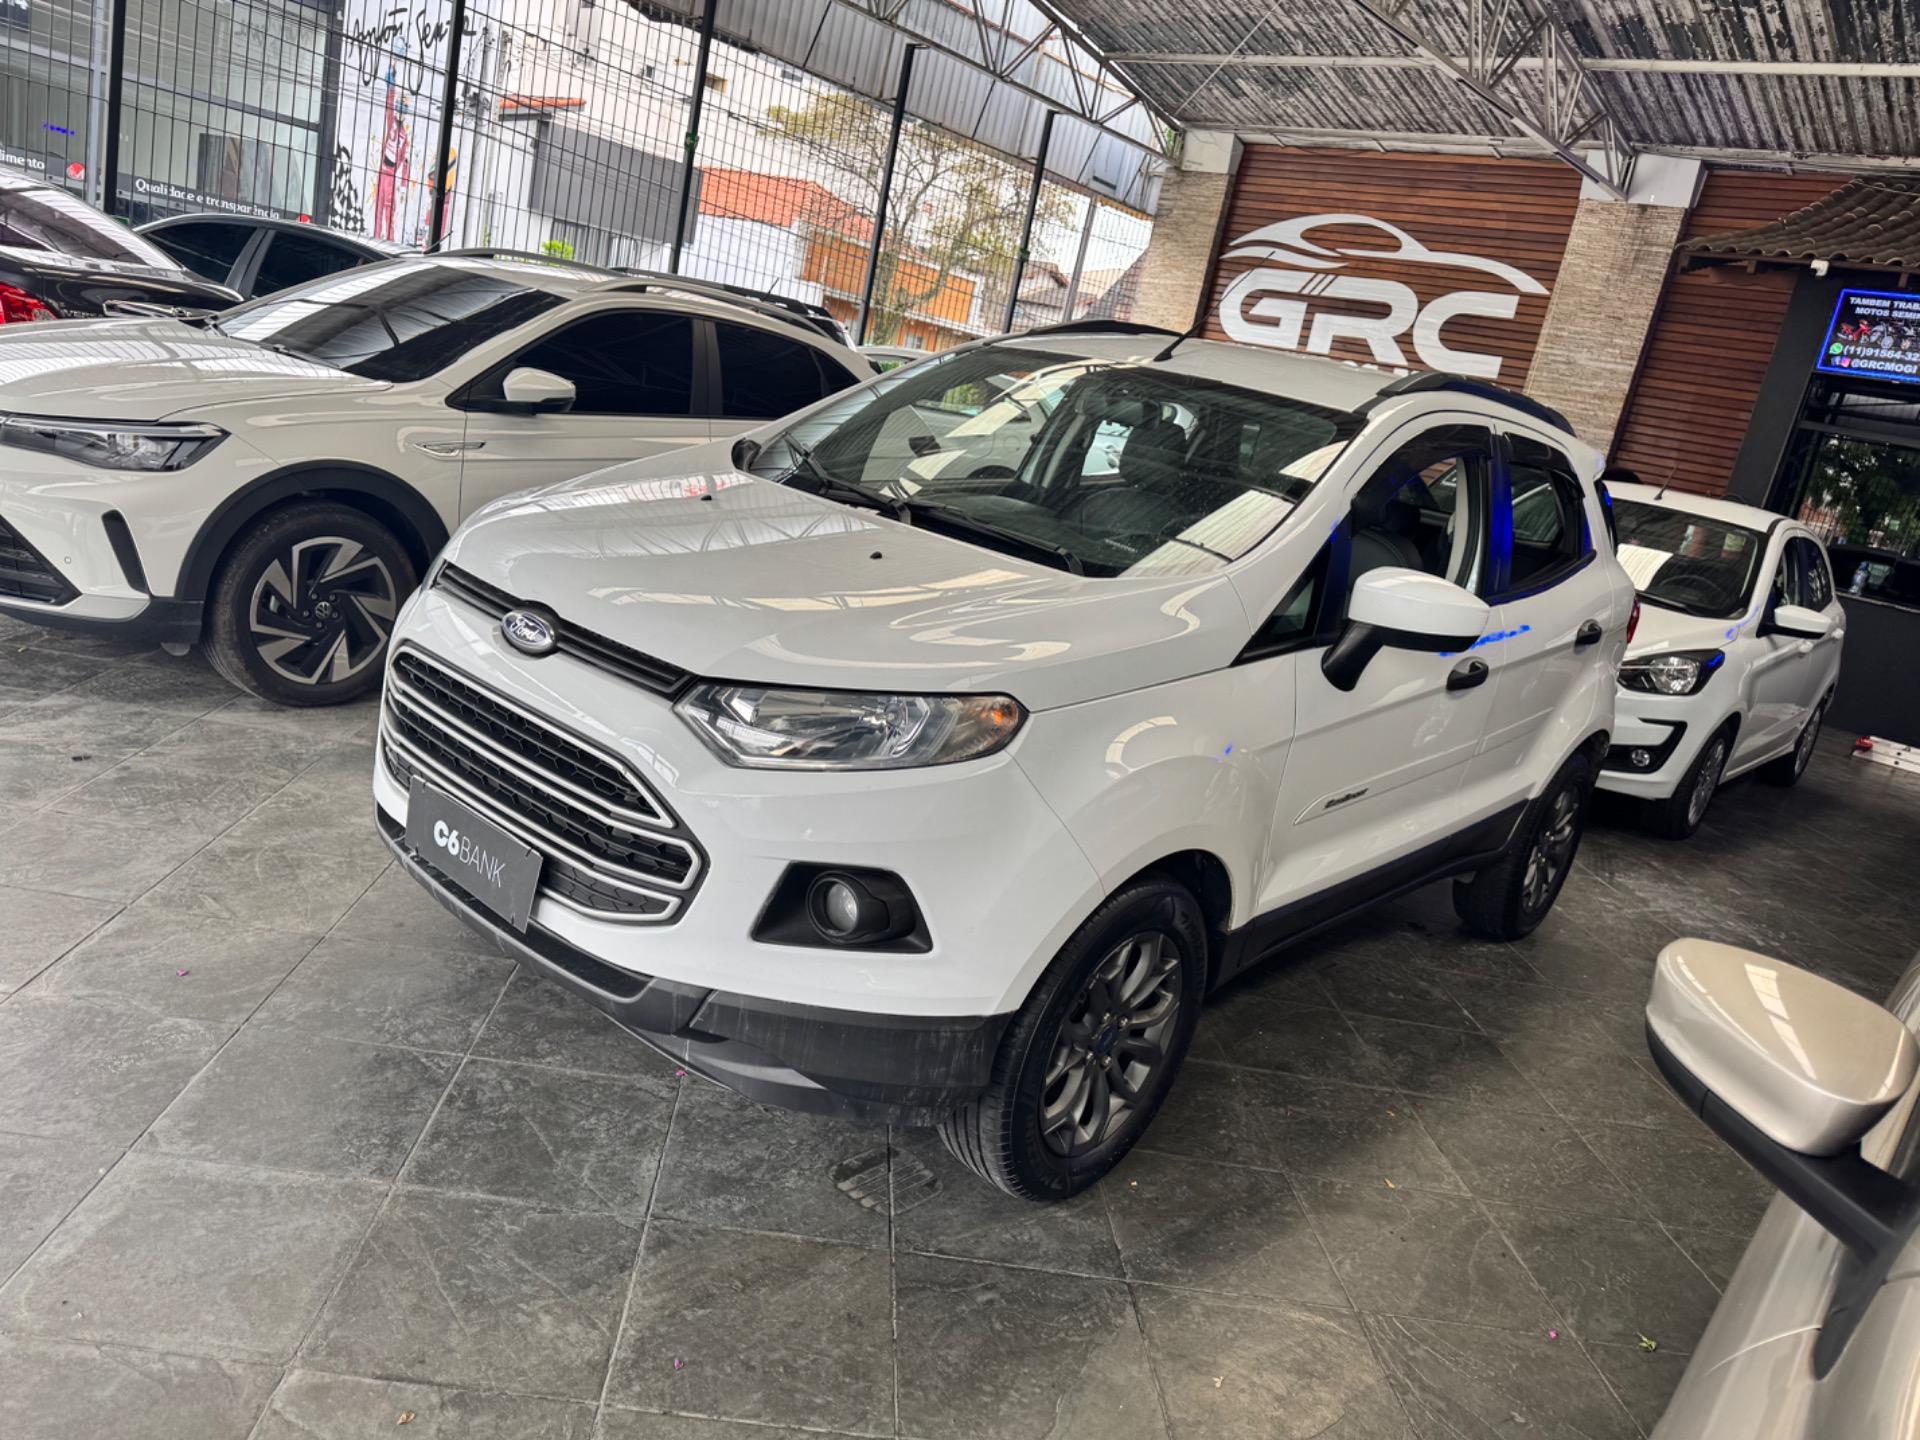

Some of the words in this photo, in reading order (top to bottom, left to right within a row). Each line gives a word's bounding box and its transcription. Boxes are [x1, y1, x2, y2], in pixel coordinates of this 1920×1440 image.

[1854, 307, 1889, 317] MOTOS
[1219, 267, 1520, 379] GRC
[1851, 358, 1918, 374] @GRCMOGI
